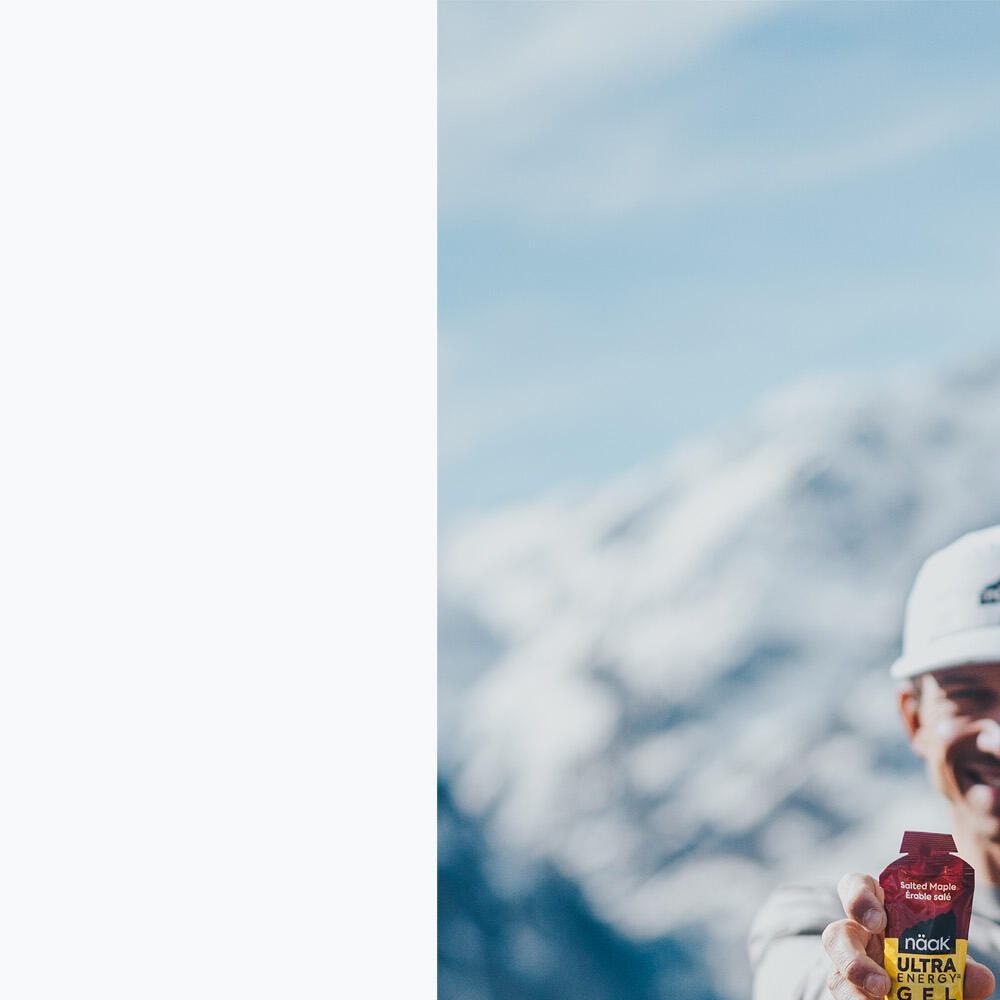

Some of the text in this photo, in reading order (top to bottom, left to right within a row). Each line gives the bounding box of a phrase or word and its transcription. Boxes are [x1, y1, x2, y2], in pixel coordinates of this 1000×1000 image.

[900, 881, 957, 891] Salted Maple
[905, 890, 952, 901] Érable salé
[905, 934, 950, 951] näak
[897, 957, 956, 973] ULTRA
